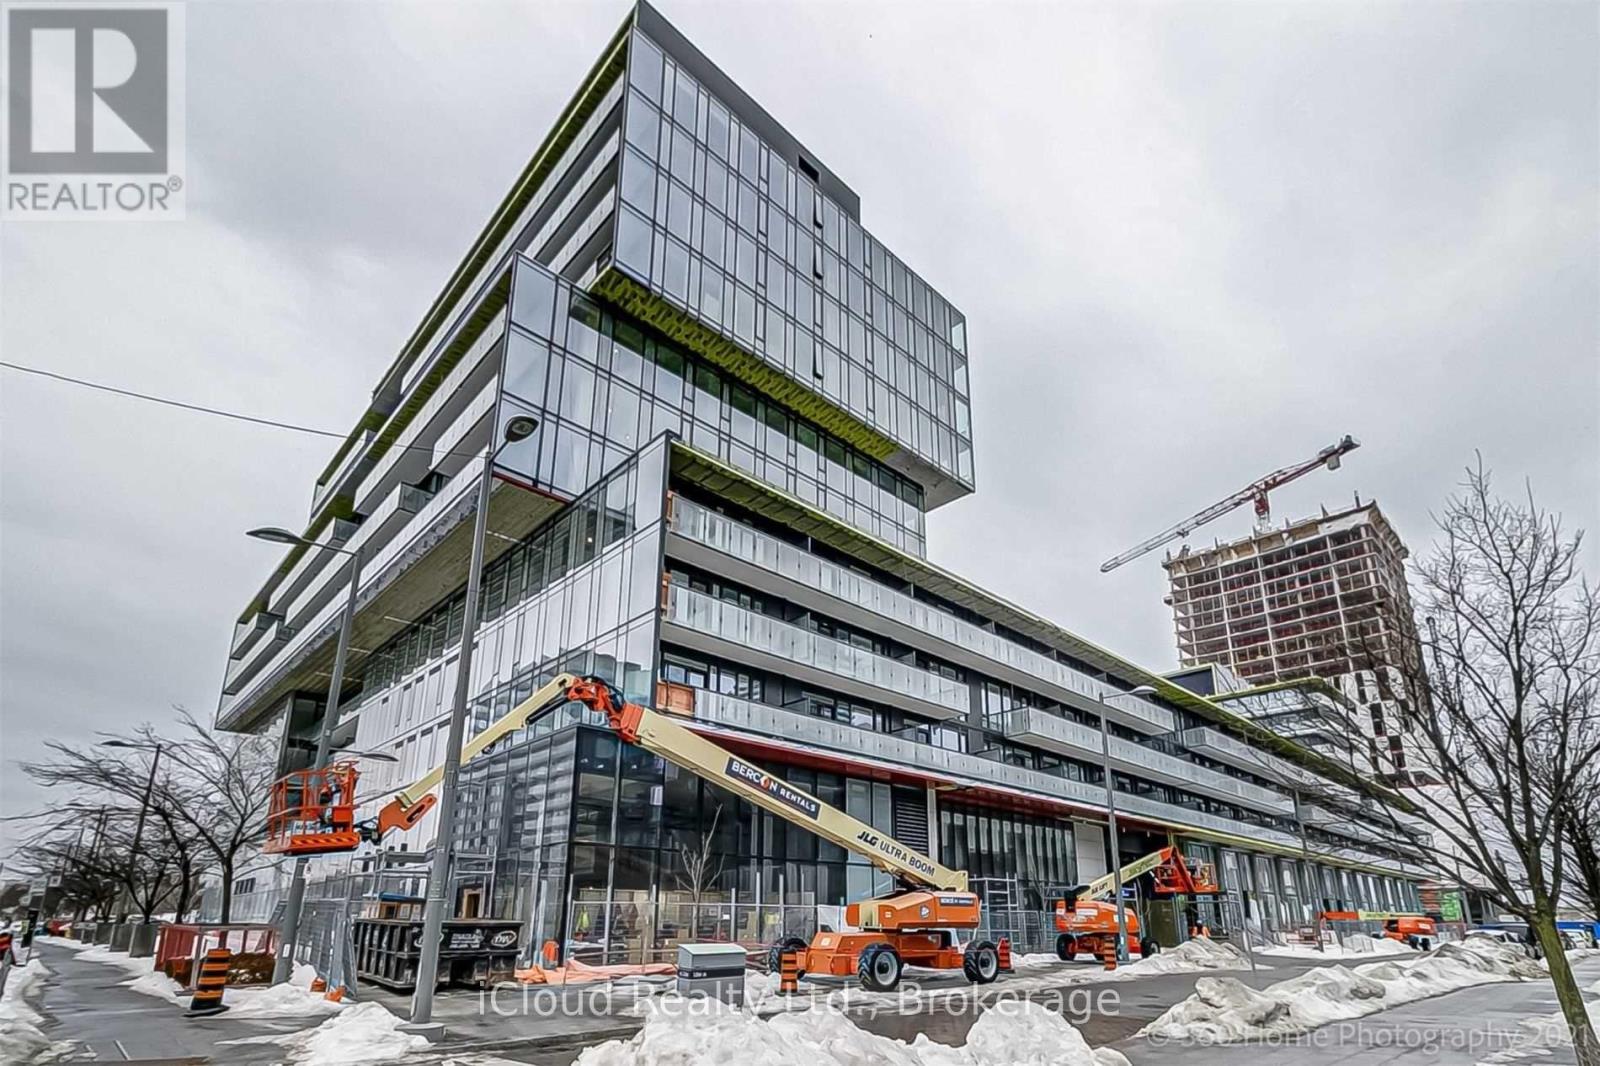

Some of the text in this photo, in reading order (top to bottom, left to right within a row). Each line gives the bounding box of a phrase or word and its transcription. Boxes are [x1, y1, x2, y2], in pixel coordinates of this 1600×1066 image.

[731, 760, 816, 812] BERCON RENTALS
[857, 831, 935, 876] JLG ULTRA BOOM
